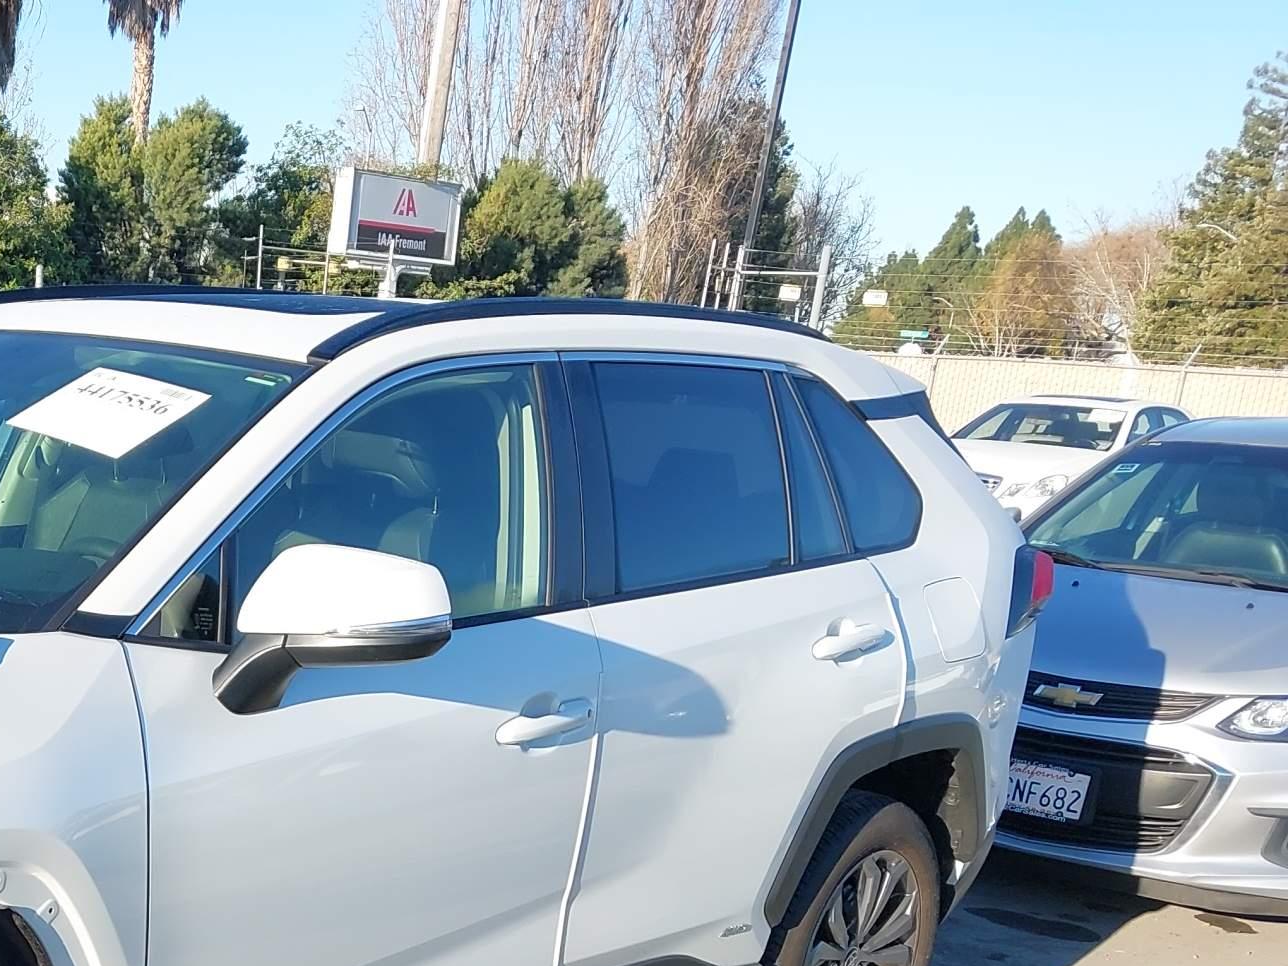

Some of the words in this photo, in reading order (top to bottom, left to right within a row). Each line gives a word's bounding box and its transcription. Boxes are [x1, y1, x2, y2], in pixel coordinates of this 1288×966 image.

[378, 231, 393, 247] IAA
[394, 234, 427, 251] Fremont
[76, 383, 172, 415] 44175536
